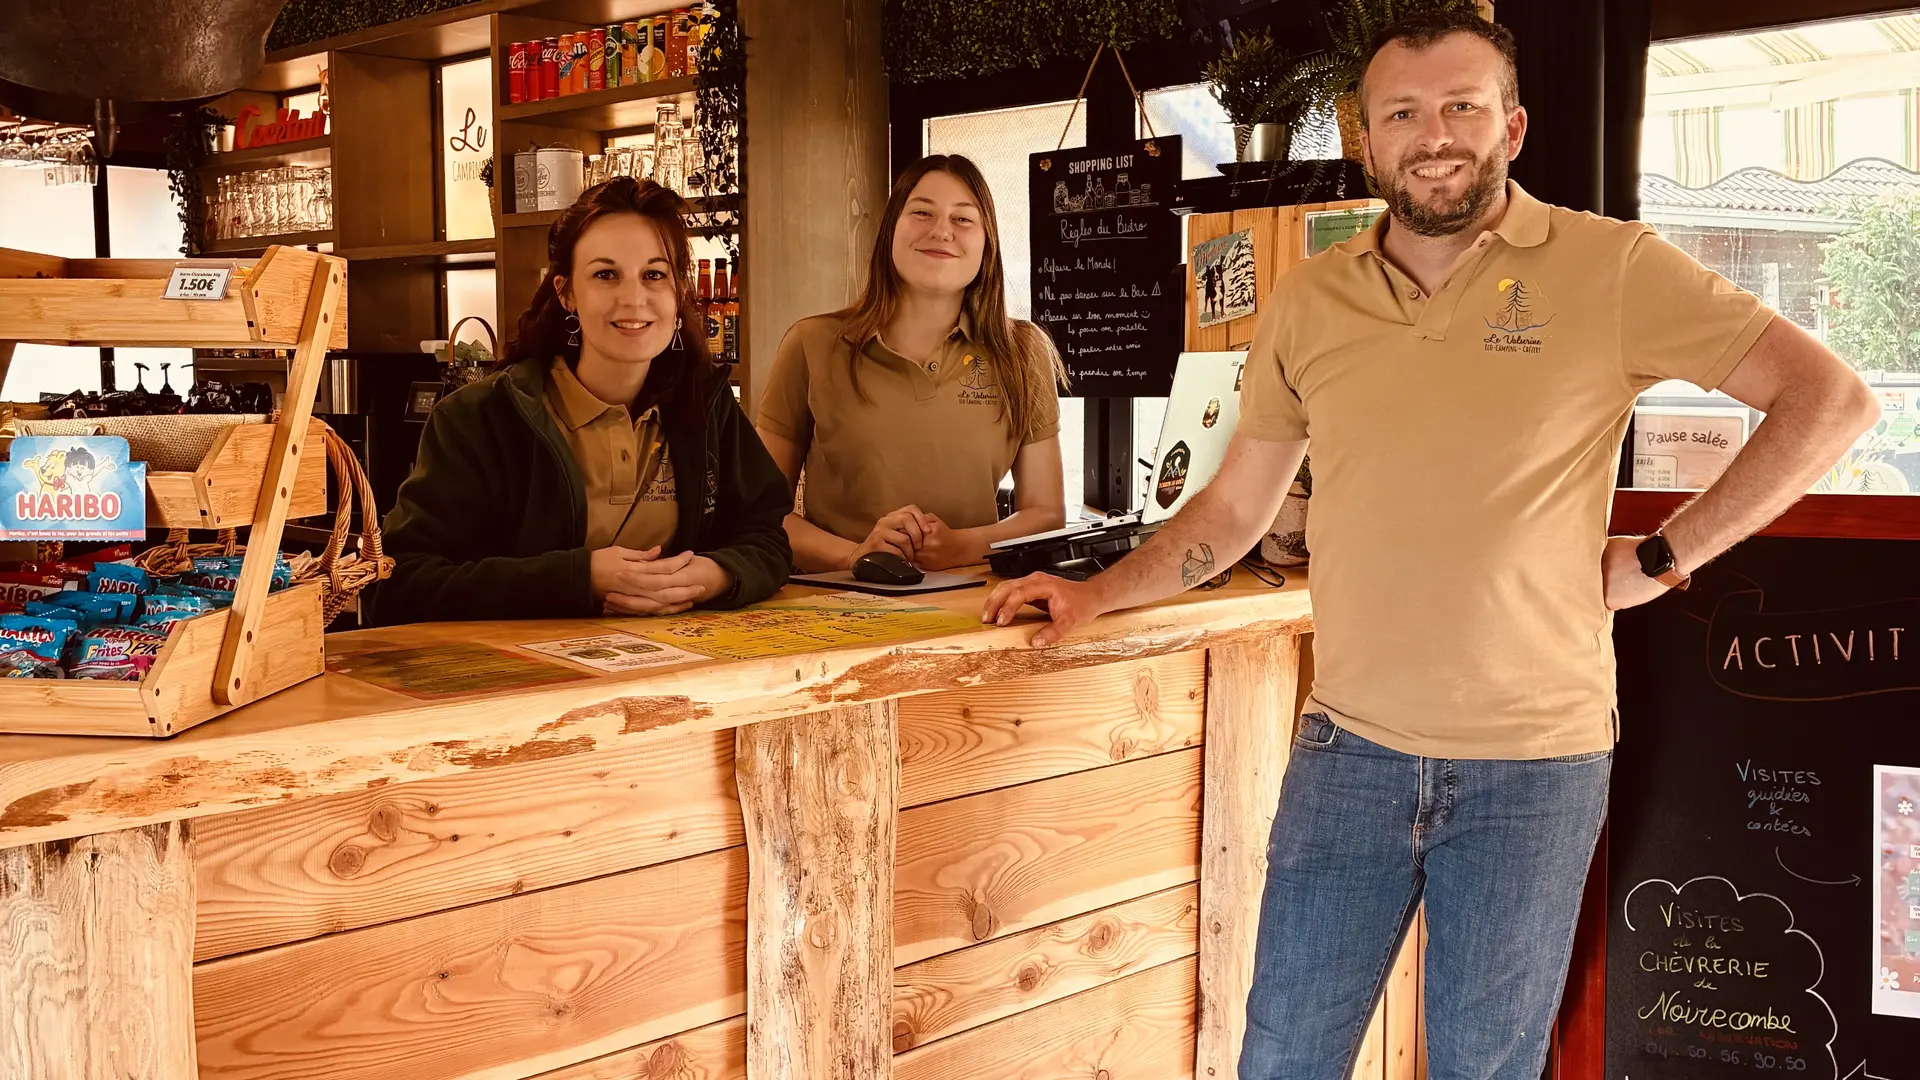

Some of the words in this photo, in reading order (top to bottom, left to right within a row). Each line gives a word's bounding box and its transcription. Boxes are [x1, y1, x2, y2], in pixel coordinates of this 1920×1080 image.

[450, 107, 487, 152] Le
[452, 161, 486, 181] CAMPIN
[1069, 157, 1113, 174] SHOPPING
[1116, 155, 1134, 169] LIST
[1060, 218, 1093, 248] Règles
[1097, 219, 1111, 235] du
[1117, 214, 1148, 234] Bistro
[1043, 257, 1071, 282] Refaire
[1074, 258, 1085, 270] le
[179, 278, 216, 291] 1.50€
[1044, 286, 1055, 300] Ne
[1059, 292, 1073, 305] pas
[1074, 288, 1099, 299] danser
[1119, 288, 1129, 298] le
[1131, 284, 1148, 298] Bar
[1086, 311, 1102, 320] bon
[1105, 310, 1139, 319] moment
[1116, 322, 1148, 336] portable
[1483, 333, 1501, 344] Le
[1646, 431, 1687, 445] Pause
[1691, 430, 1728, 449] salée
[17, 492, 120, 519] HARIBO
[86, 645, 124, 660] Frites
[1723, 628, 1905, 670] ACTIVIT
[1736, 759, 1821, 785] VISITES
[1748, 786, 1810, 808] guidées
[1747, 820, 1812, 836] contées
[1705, 935, 1721, 950] la
[1640, 951, 1769, 978] CHÈVRERIE
[1694, 977, 1717, 990] de
[1638, 991, 1796, 1034] Noirecombe
